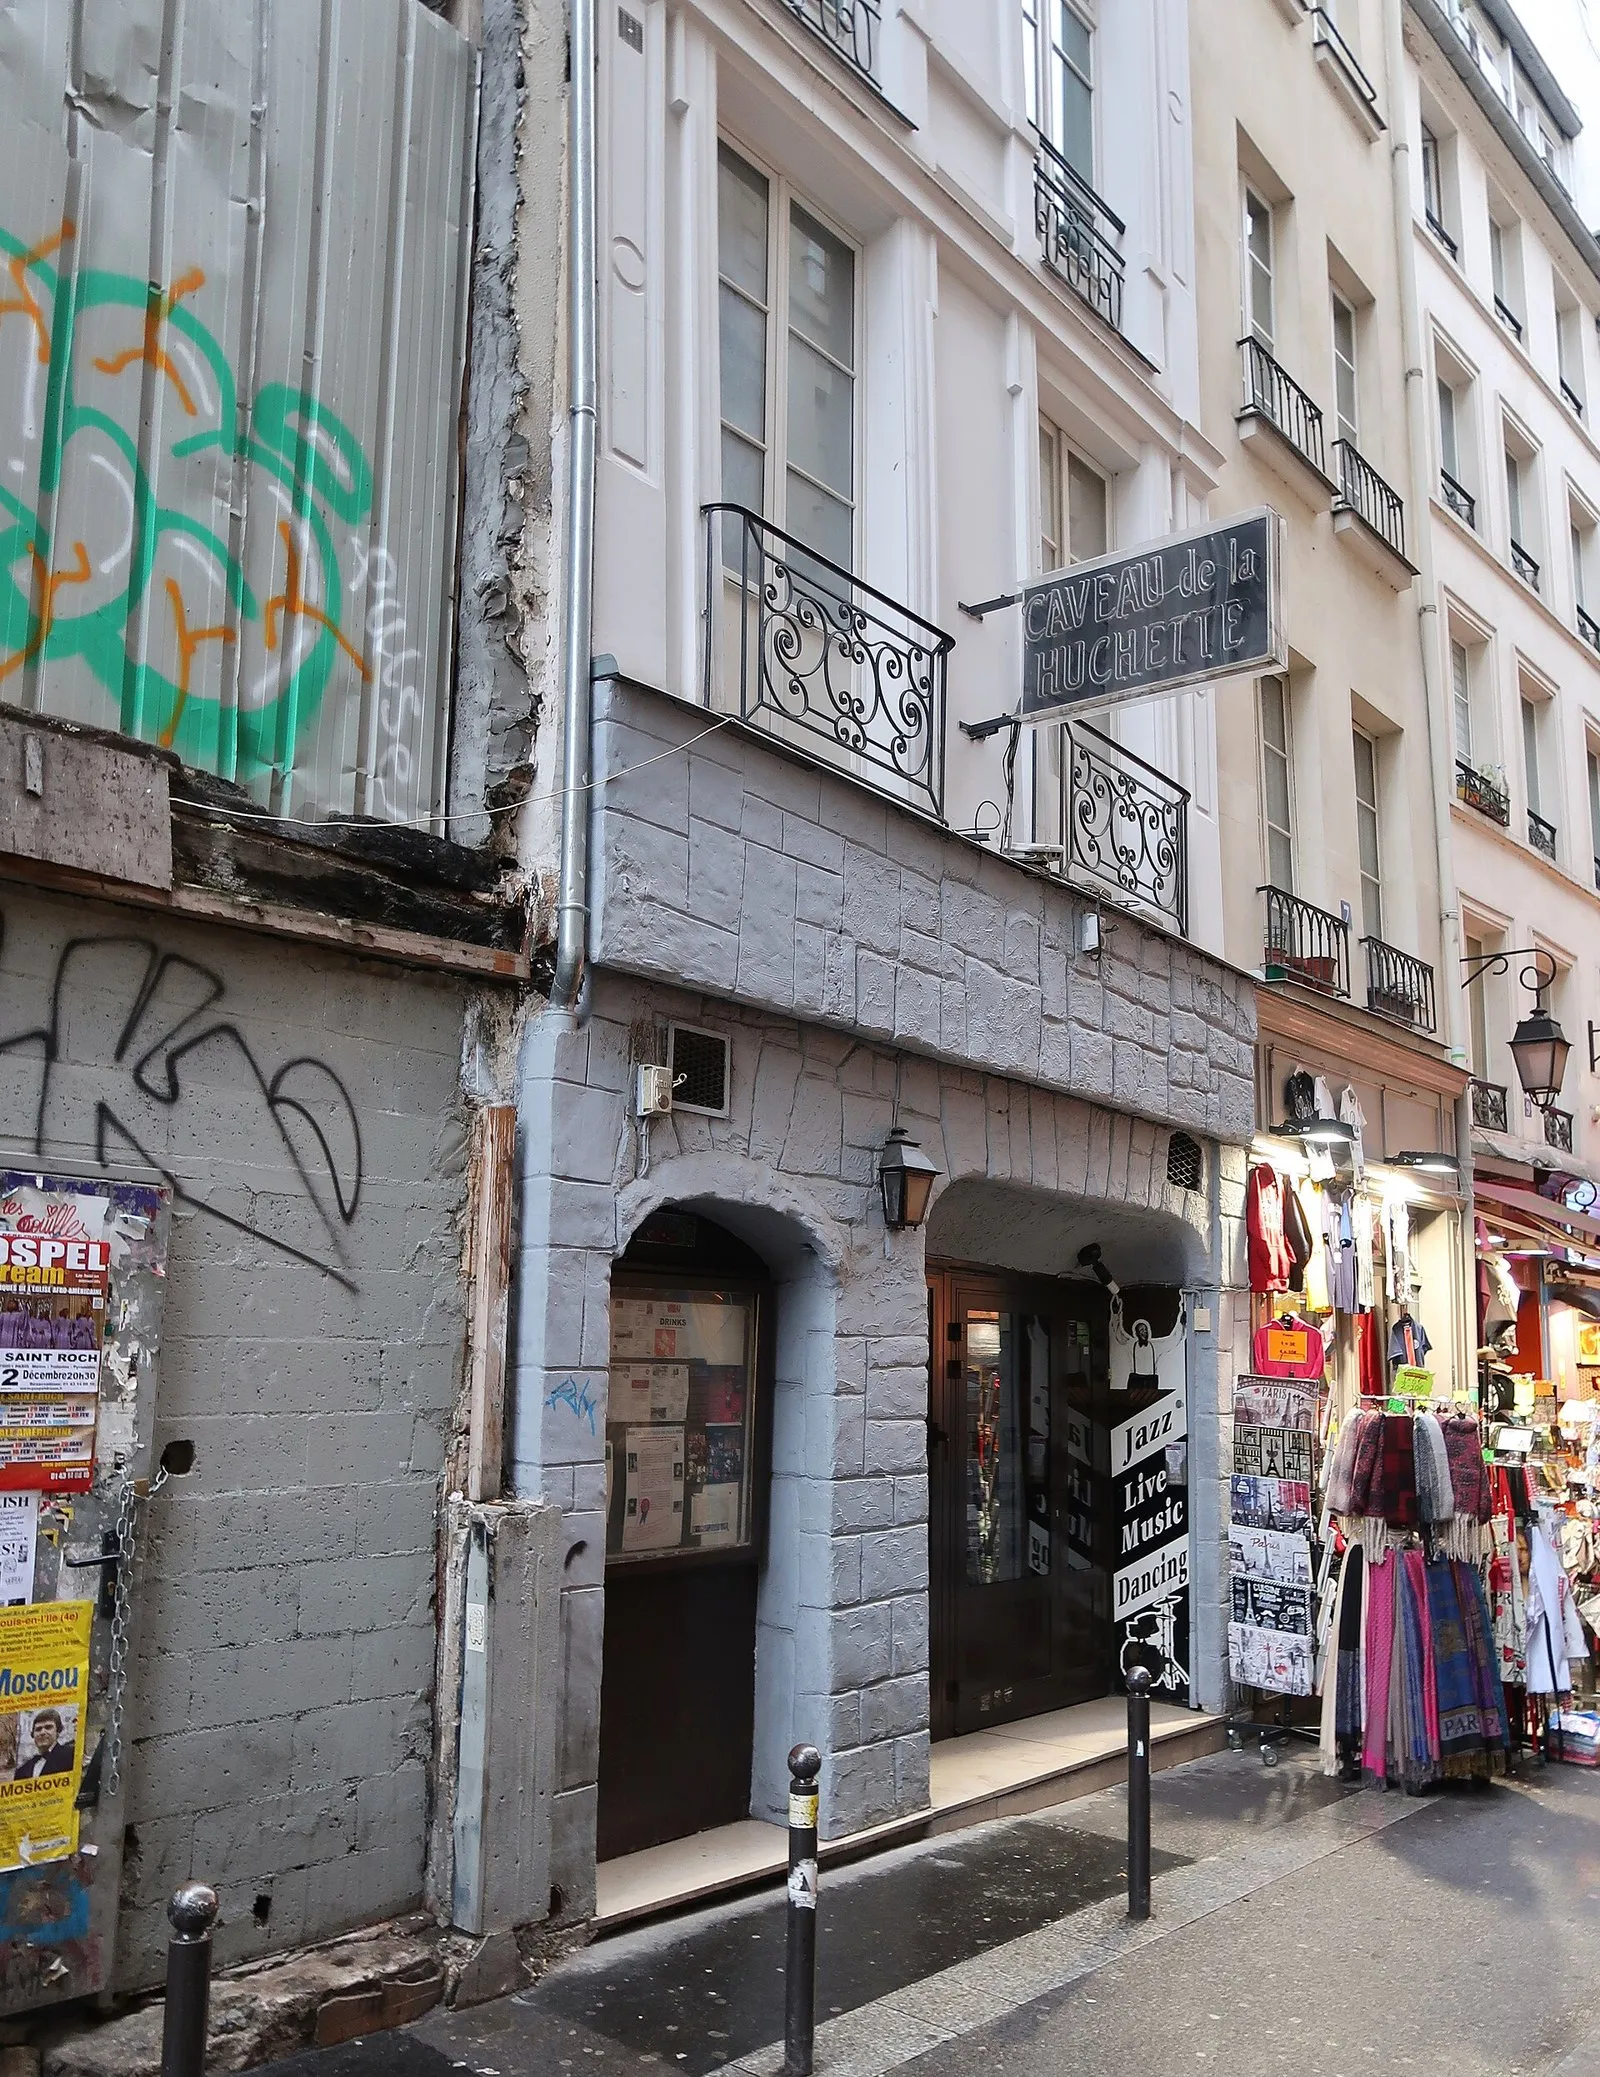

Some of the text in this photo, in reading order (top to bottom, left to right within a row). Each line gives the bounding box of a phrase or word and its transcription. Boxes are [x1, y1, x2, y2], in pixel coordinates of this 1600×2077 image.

[1023, 537, 1260, 642] CAVEAU de la
[1036, 598, 1250, 698] HUCHETTE
[660, 1317, 687, 1327] DRINKS
[5, 1352, 97, 1362] SAINT ROCH
[1261, 1387, 1287, 1400] PARIS
[1122, 1410, 1173, 1467] Jazz
[0, 1496, 29, 1509] ISH
[1124, 1469, 1167, 1512] Live
[1121, 1496, 1183, 1555] Music
[1118, 1550, 1188, 1608] Dancing
[0, 1667, 78, 1696] Moscou
[0, 1776, 70, 1798] Moskova
